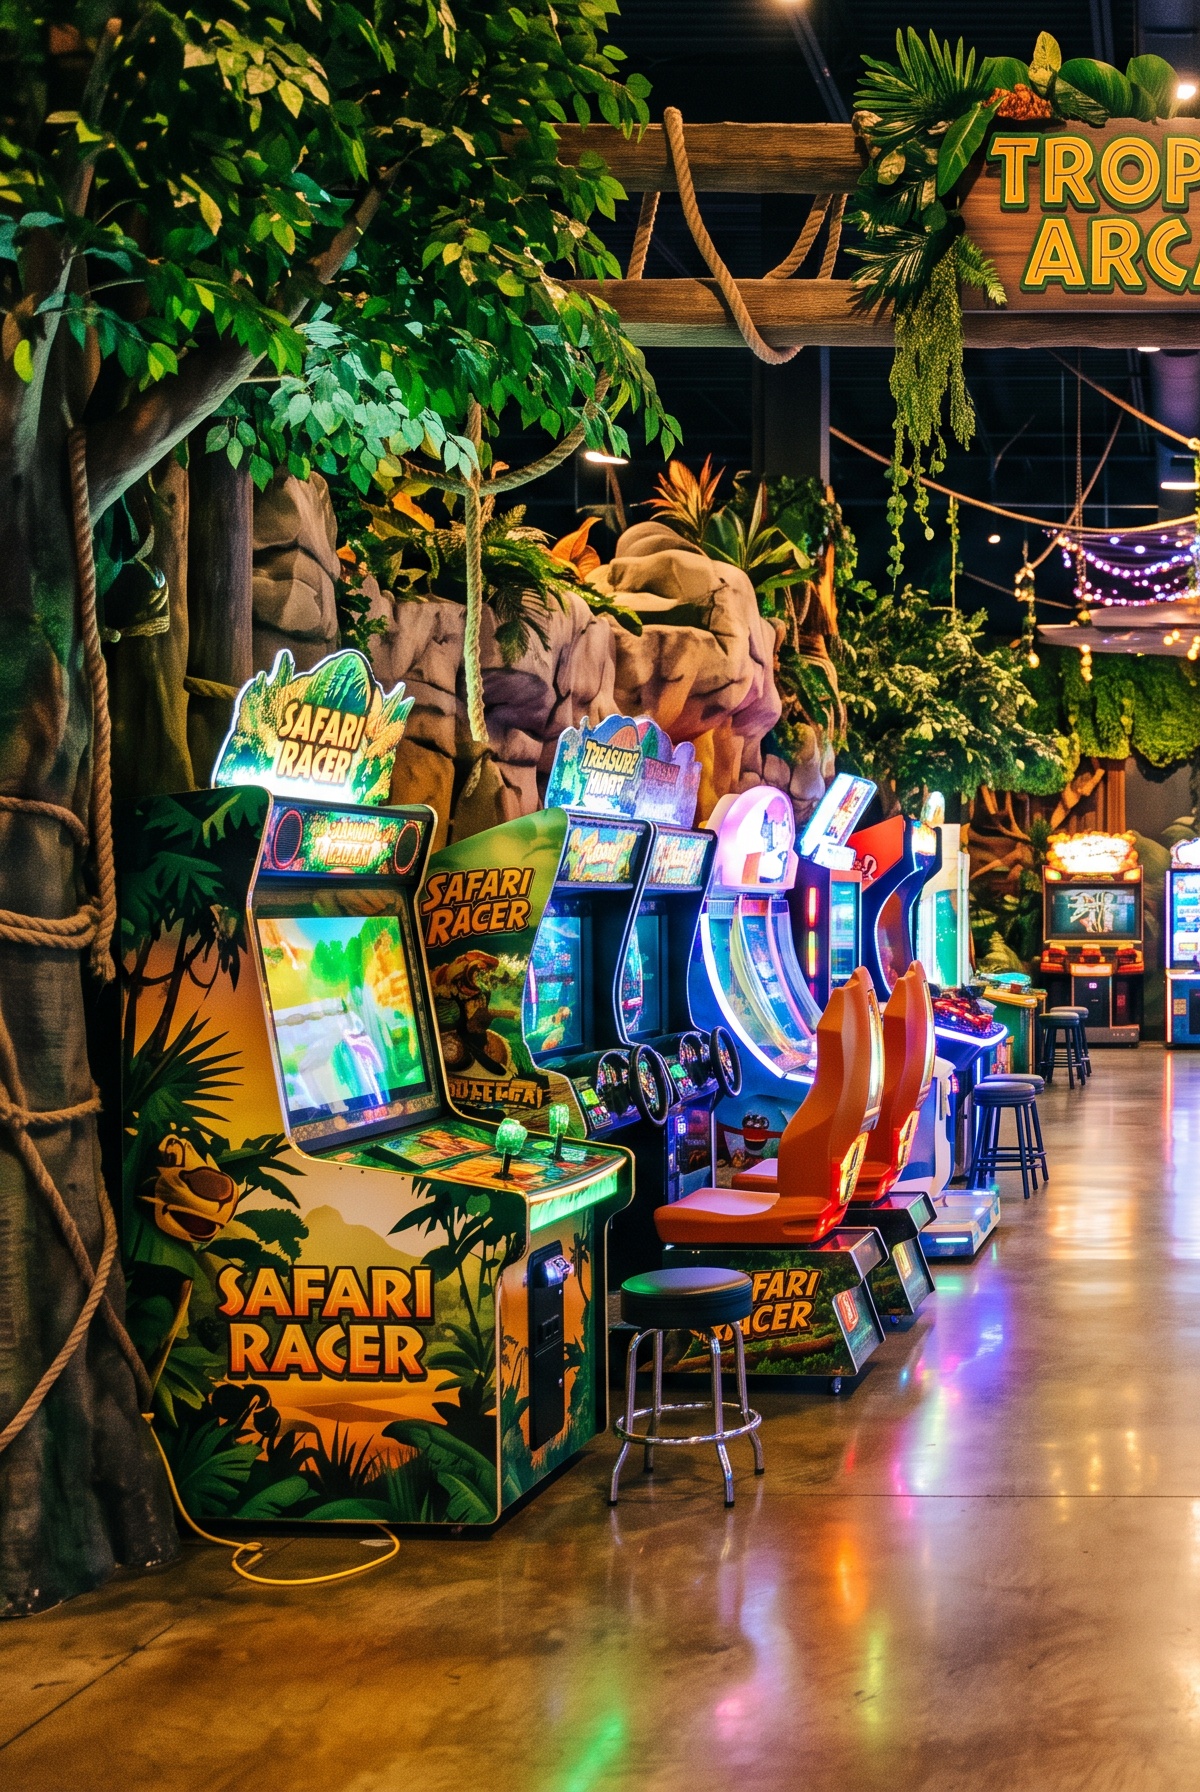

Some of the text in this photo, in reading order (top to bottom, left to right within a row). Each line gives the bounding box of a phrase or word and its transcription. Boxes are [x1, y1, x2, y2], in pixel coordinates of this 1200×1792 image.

[278, 701, 367, 750] SAFARI
[277, 740, 352, 785] RACER
[422, 869, 533, 913] SAFARI
[427, 900, 530, 945] RACER
[218, 1266, 432, 1318] SAFARI
[229, 1323, 424, 1375] RACER
